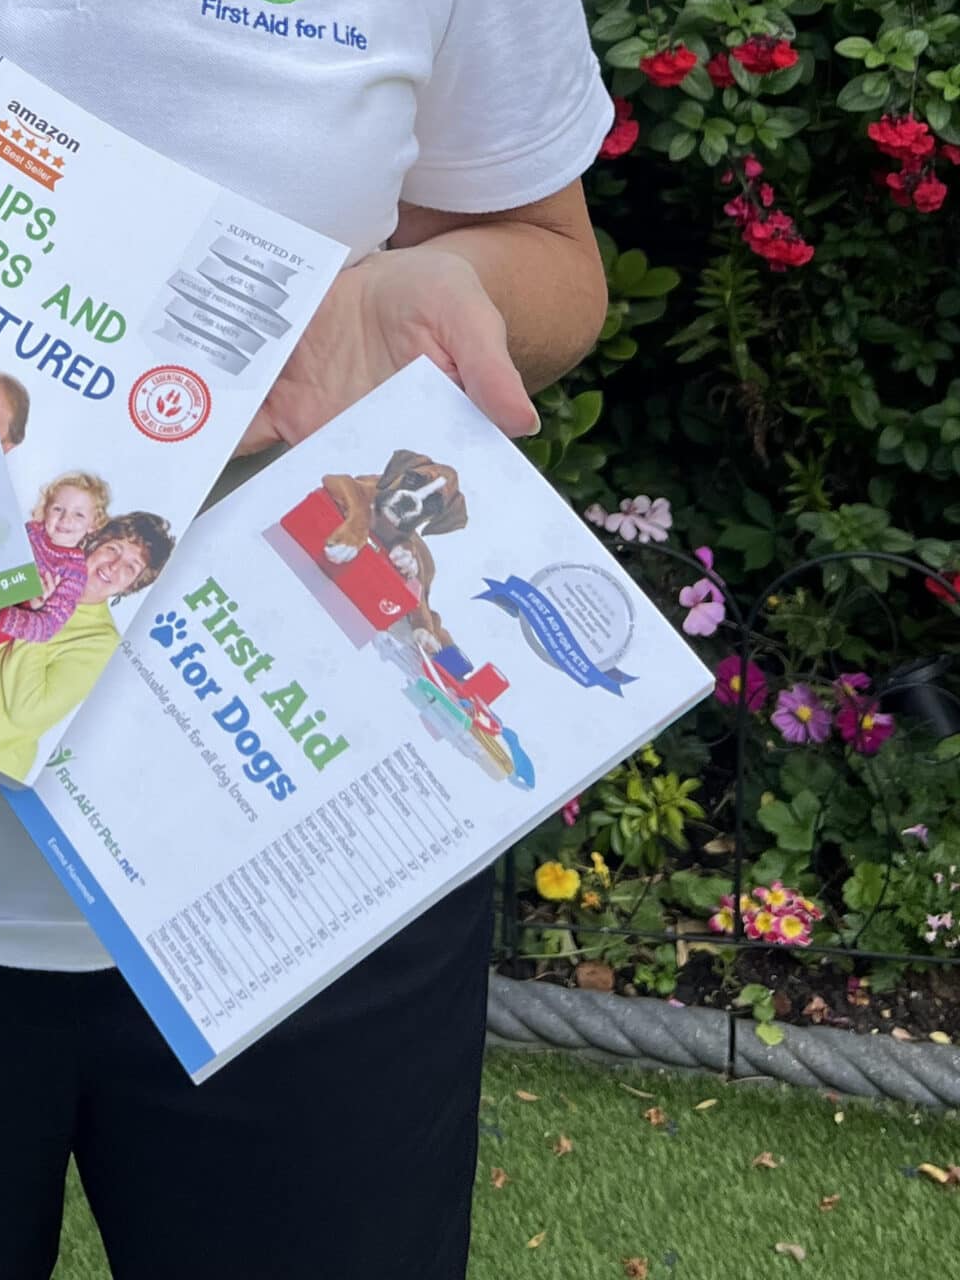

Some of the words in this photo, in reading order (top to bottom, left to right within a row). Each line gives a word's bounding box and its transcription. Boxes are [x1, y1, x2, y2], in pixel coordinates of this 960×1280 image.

[253, 11, 289, 36] Aid
[295, 19, 327, 39] for
[333, 22, 368, 50] Life
[7, 99, 81, 153] amazon
[3, 144, 25, 165] Best
[24, 159, 52, 181] Seller
[226, 223, 289, 259] SUPPORTED
[288, 253, 304, 267] BY
[41, 283, 126, 343] AND
[526, 590, 551, 617] FIRST
[544, 614, 560, 632] AID
[554, 630, 573, 651] FOR
[568, 648, 590, 673] PETS
[182, 575, 276, 684] First
[260, 680, 350, 772] Aid
[120, 639, 133, 660] An
[131, 654, 171, 705] invaluable
[162, 701, 192, 732] guide
[187, 726, 205, 749] for
[200, 748, 218, 767] all
[211, 763, 231, 788] dog
[228, 782, 259, 823] lovers
[169, 642, 223, 701] for
[211, 695, 297, 801] Dogs
[55, 767, 79, 796] First
[73, 792, 93, 817] Aid
[87, 812, 105, 833] for
